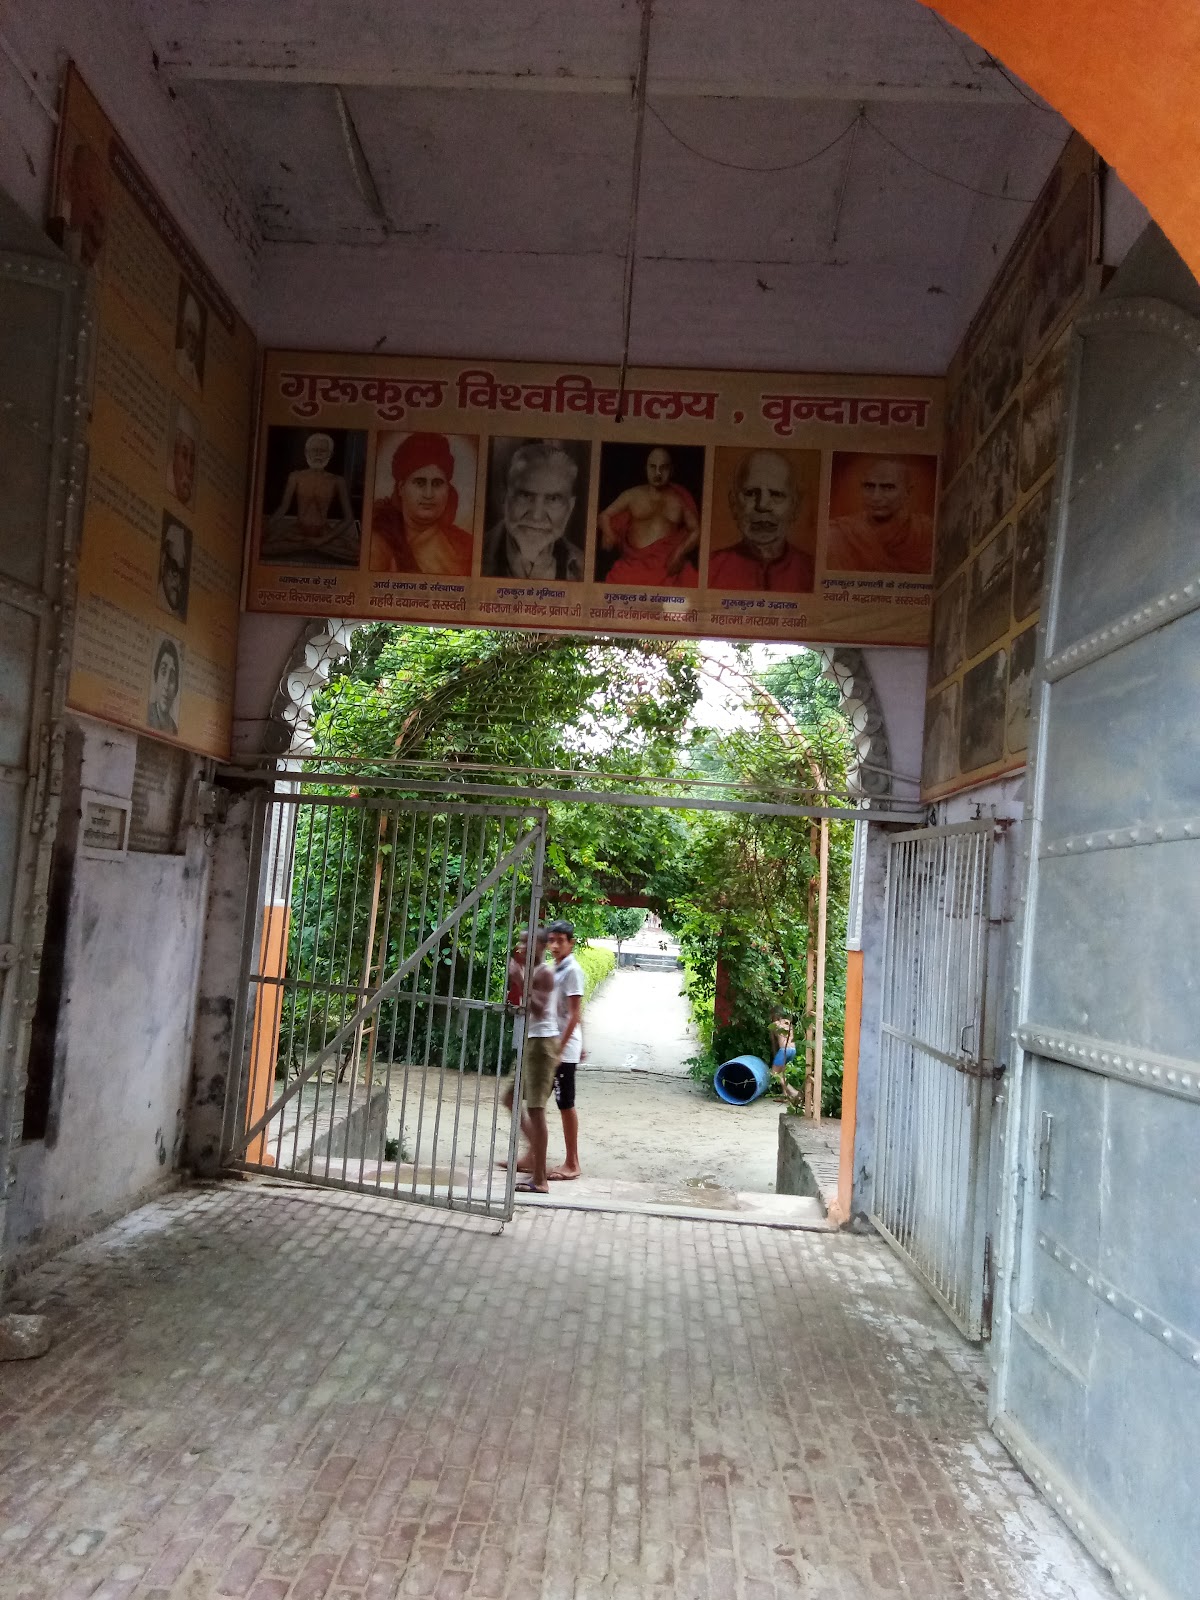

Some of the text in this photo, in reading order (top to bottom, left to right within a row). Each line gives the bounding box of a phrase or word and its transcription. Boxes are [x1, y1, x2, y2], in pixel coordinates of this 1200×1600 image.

[456, 370, 719, 419] विश्वविद्यालय
[762, 394, 930, 436] वृन्दावन
[279, 576, 337, 589] व्याकरण के सूर्य
[373, 579, 465, 593] आर्य समाज के संस्थापक
[857, 579, 884, 589] प्रणाली
[886, 580, 895, 589] के
[335, 592, 355, 607] दण्डी
[527, 587, 534, 596] के
[536, 588, 566, 600] भूमिदाता
[639, 593, 647, 602] के
[650, 593, 685, 604] संस्थापक
[823, 590, 931, 606] स्वामी श्रद्धानन्द सरस्वती
[369, 593, 466, 611] महर्षि दयानन्द सरस्वती
[479, 600, 581, 617] महाराजा श्री महेन्द्र प्रताप जी
[756, 599, 765, 608] के
[589, 604, 698, 623] स्वामी दर्शनानन्द सरस्वती
[711, 614, 807, 628] महात्मा नारायण स्वामी
